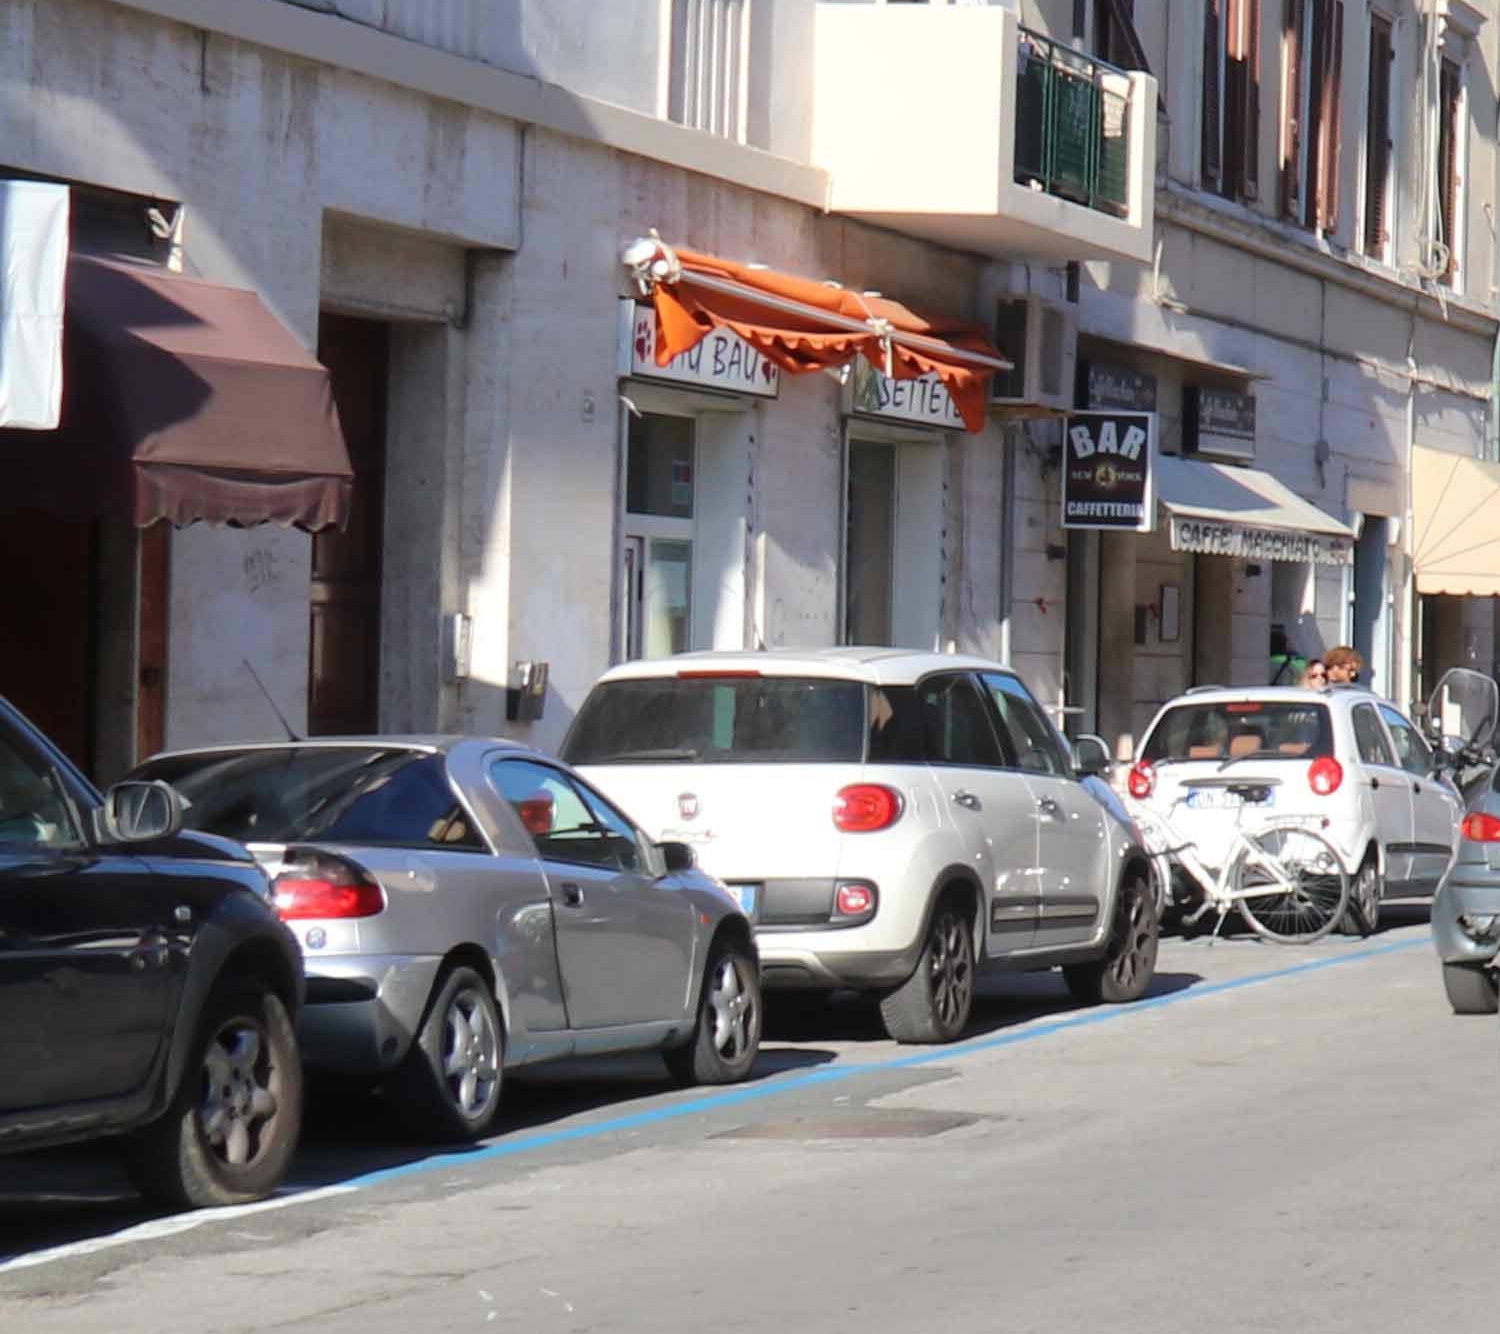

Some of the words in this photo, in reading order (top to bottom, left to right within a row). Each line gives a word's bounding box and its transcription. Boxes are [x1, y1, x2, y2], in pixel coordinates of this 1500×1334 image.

[713, 336, 759, 384] BAU
[1070, 421, 1146, 460] BAR
[1067, 501, 1145, 517] CAFFETTERIA
